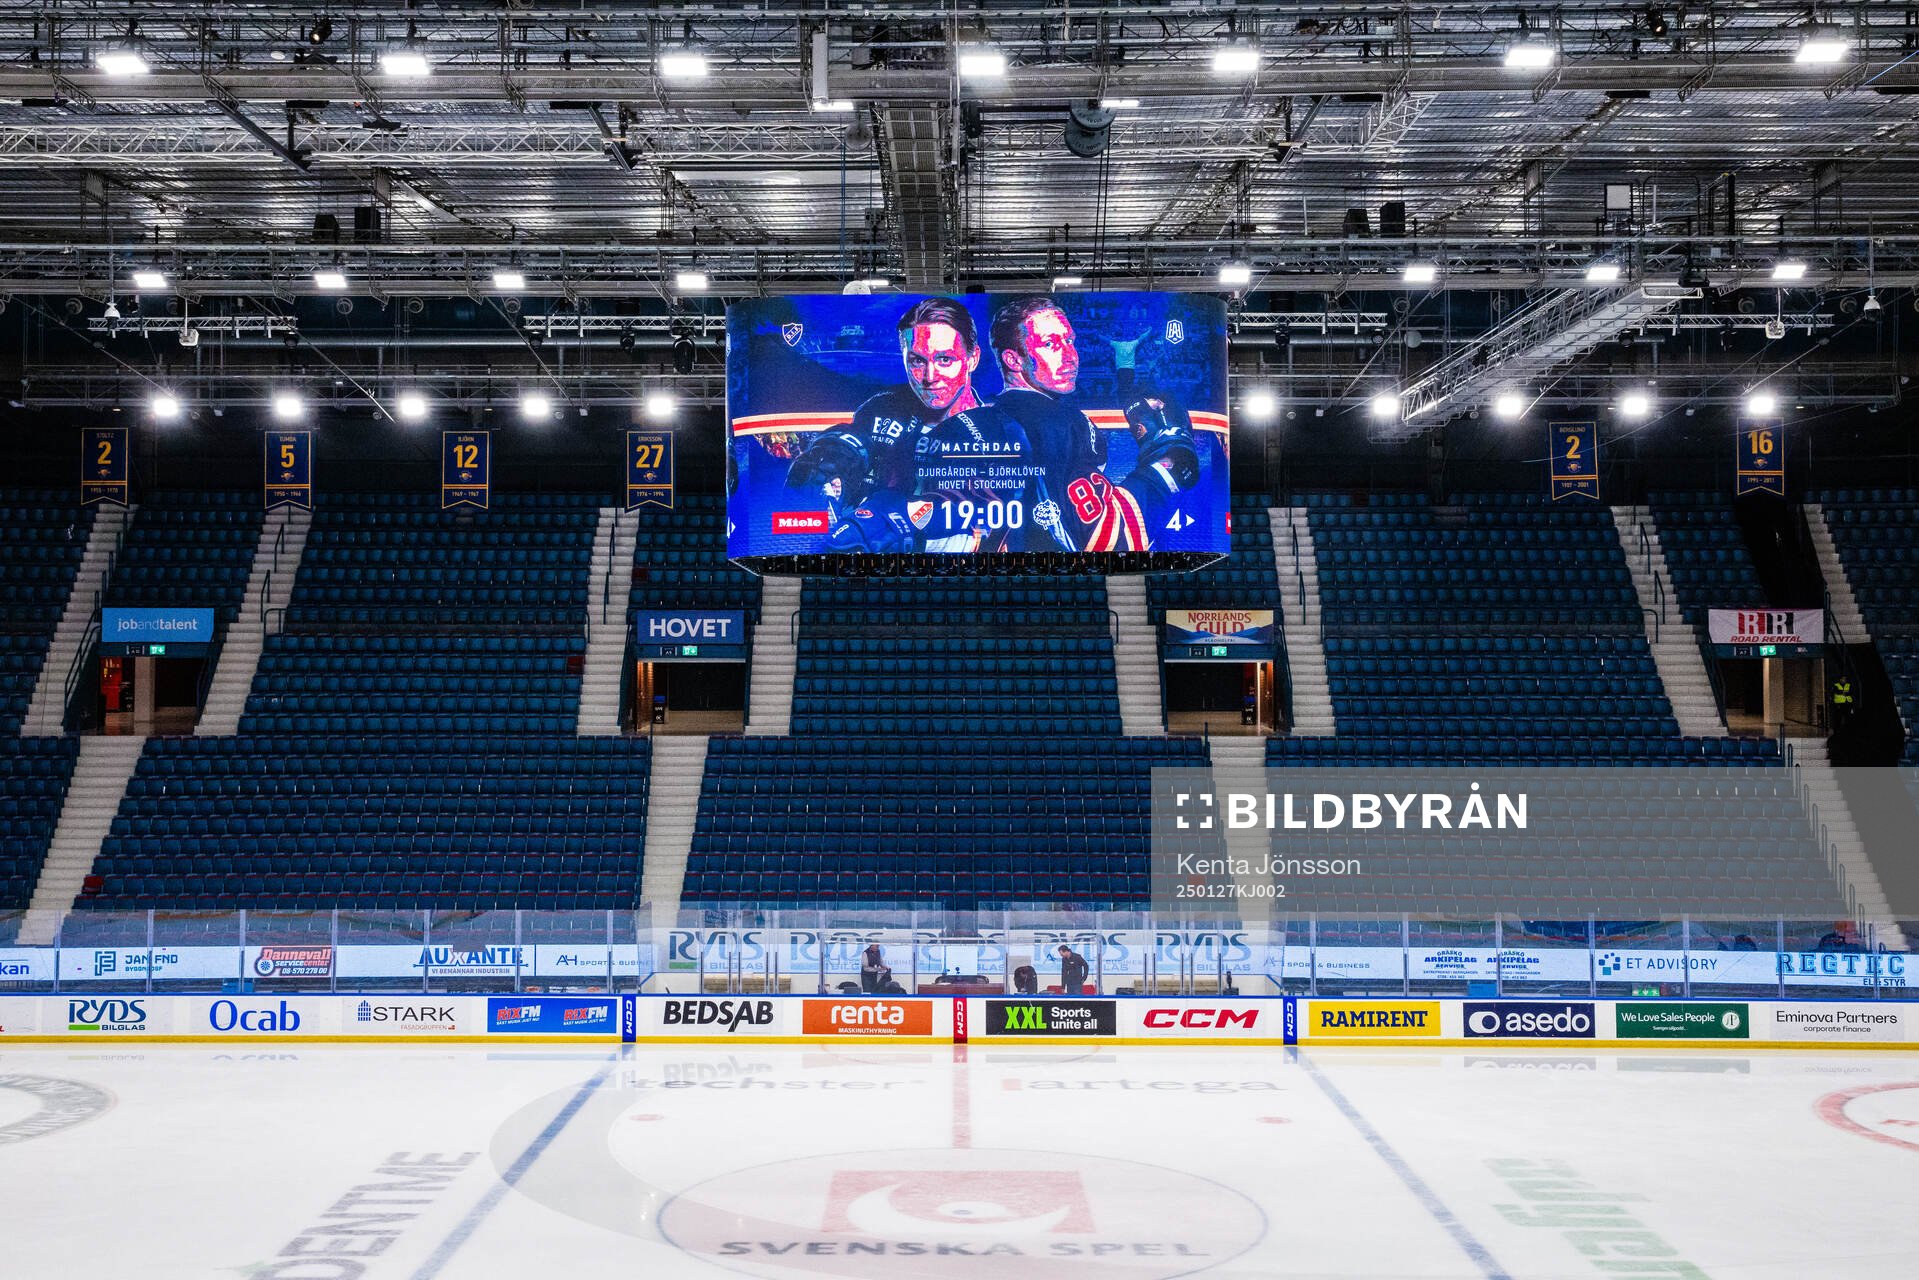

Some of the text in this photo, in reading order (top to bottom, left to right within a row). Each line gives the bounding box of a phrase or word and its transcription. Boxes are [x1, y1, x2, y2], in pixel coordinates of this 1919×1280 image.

[941, 442, 1022, 453] MATCHDAG
[1565, 434, 1581, 459] 2
[1747, 430, 1774, 455] 16
[97, 440, 112, 465] 2
[280, 444, 295, 469] 5
[453, 444, 479, 469] 12
[635, 444, 665, 469] 27
[918, 465, 977, 477] DJURGÅRDEN
[988, 465, 1046, 477] BJÖRKLÖVEN
[938, 479, 966, 490] HOVET
[973, 479, 1026, 490] STOCKHOLM
[778, 518, 823, 528] Miele
[941, 500, 1023, 530] 19:00
[1165, 508, 1182, 531] 4
[117, 618, 198, 632] jobandtalent
[1188, 612, 1252, 624] NORRLANDS
[649, 618, 732, 638] HOVET
[1195, 621, 1245, 635] GULD
[1730, 635, 1803, 643] ROAD RENTAL
[669, 931, 765, 961] RYDS
[1156, 933, 1251, 962] RYDS
[262, 949, 332, 961] Dannevall
[418, 947, 523, 964] AUXANTE
[1627, 957, 1718, 970] ET ADVISORY
[0, 962, 30, 975] kan
[1776, 952, 1905, 976] REGTEC
[1863, 978, 1873, 986] EL
[1883, 979, 1906, 987] STYR
[68, 1000, 147, 1024] RYDS
[209, 1000, 301, 1032] Ocab
[373, 1006, 455, 1022] STARK
[625, 1000, 633, 1034] CCM
[663, 1001, 774, 1033] BEDSAB
[831, 1002, 904, 1025] renta
[1005, 1006, 1047, 1030] XXL
[1051, 1006, 1092, 1019] Sports
[1143, 1009, 1259, 1029] CCM
[1286, 1003, 1294, 1037] CCM
[1321, 1011, 1428, 1027] RAMIRENT
[1505, 1007, 1591, 1033] asedo
[1621, 1012, 1715, 1024] We Love Sales People
[1776, 1010, 1898, 1024] Eminova Partners
[1051, 1018, 1098, 1030] unite all
[1842, 1025, 1872, 1033] finance
[1027, 1079, 1288, 1094] artega
[717, 1241, 1212, 1257] SVENSKA SPEL
